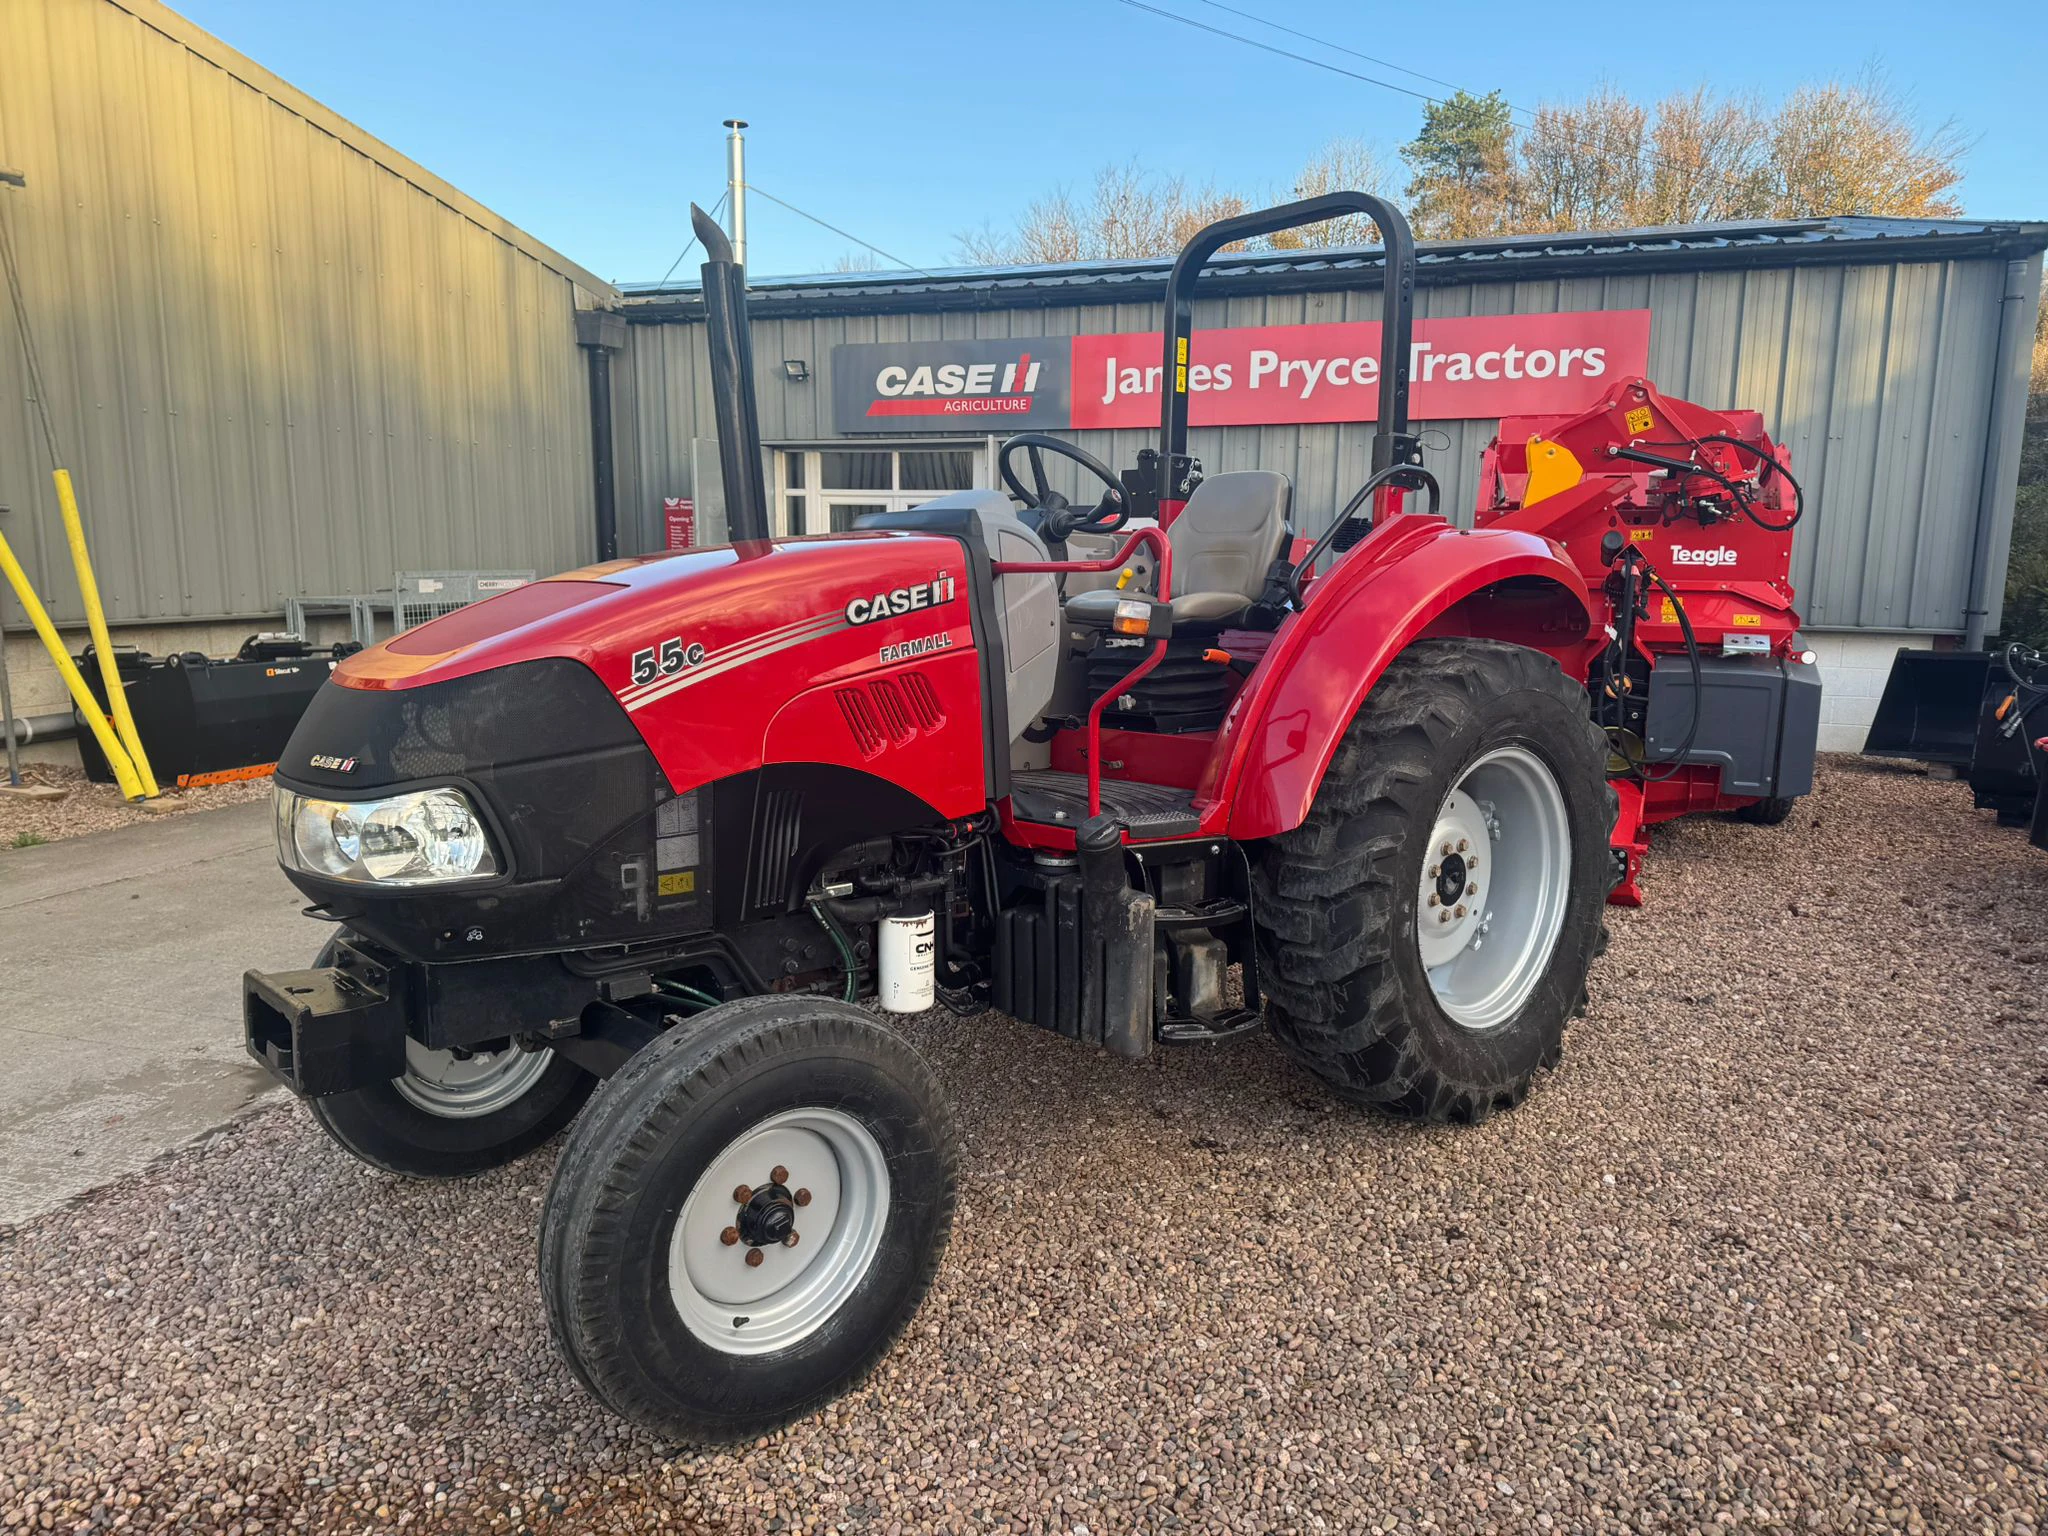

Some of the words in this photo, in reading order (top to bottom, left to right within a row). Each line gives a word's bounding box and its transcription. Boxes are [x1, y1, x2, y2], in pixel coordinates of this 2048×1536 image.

[876, 364, 997, 397] CASE
[1249, 349, 1379, 399] Pryce
[1408, 342, 1606, 383] Tractors
[943, 399, 1027, 413] AGRICULTURE
[1670, 544, 1738, 567] Teagle
[846, 583, 929, 625] CASE
[880, 631, 953, 664] FARMALL
[310, 754, 342, 770] CASE
